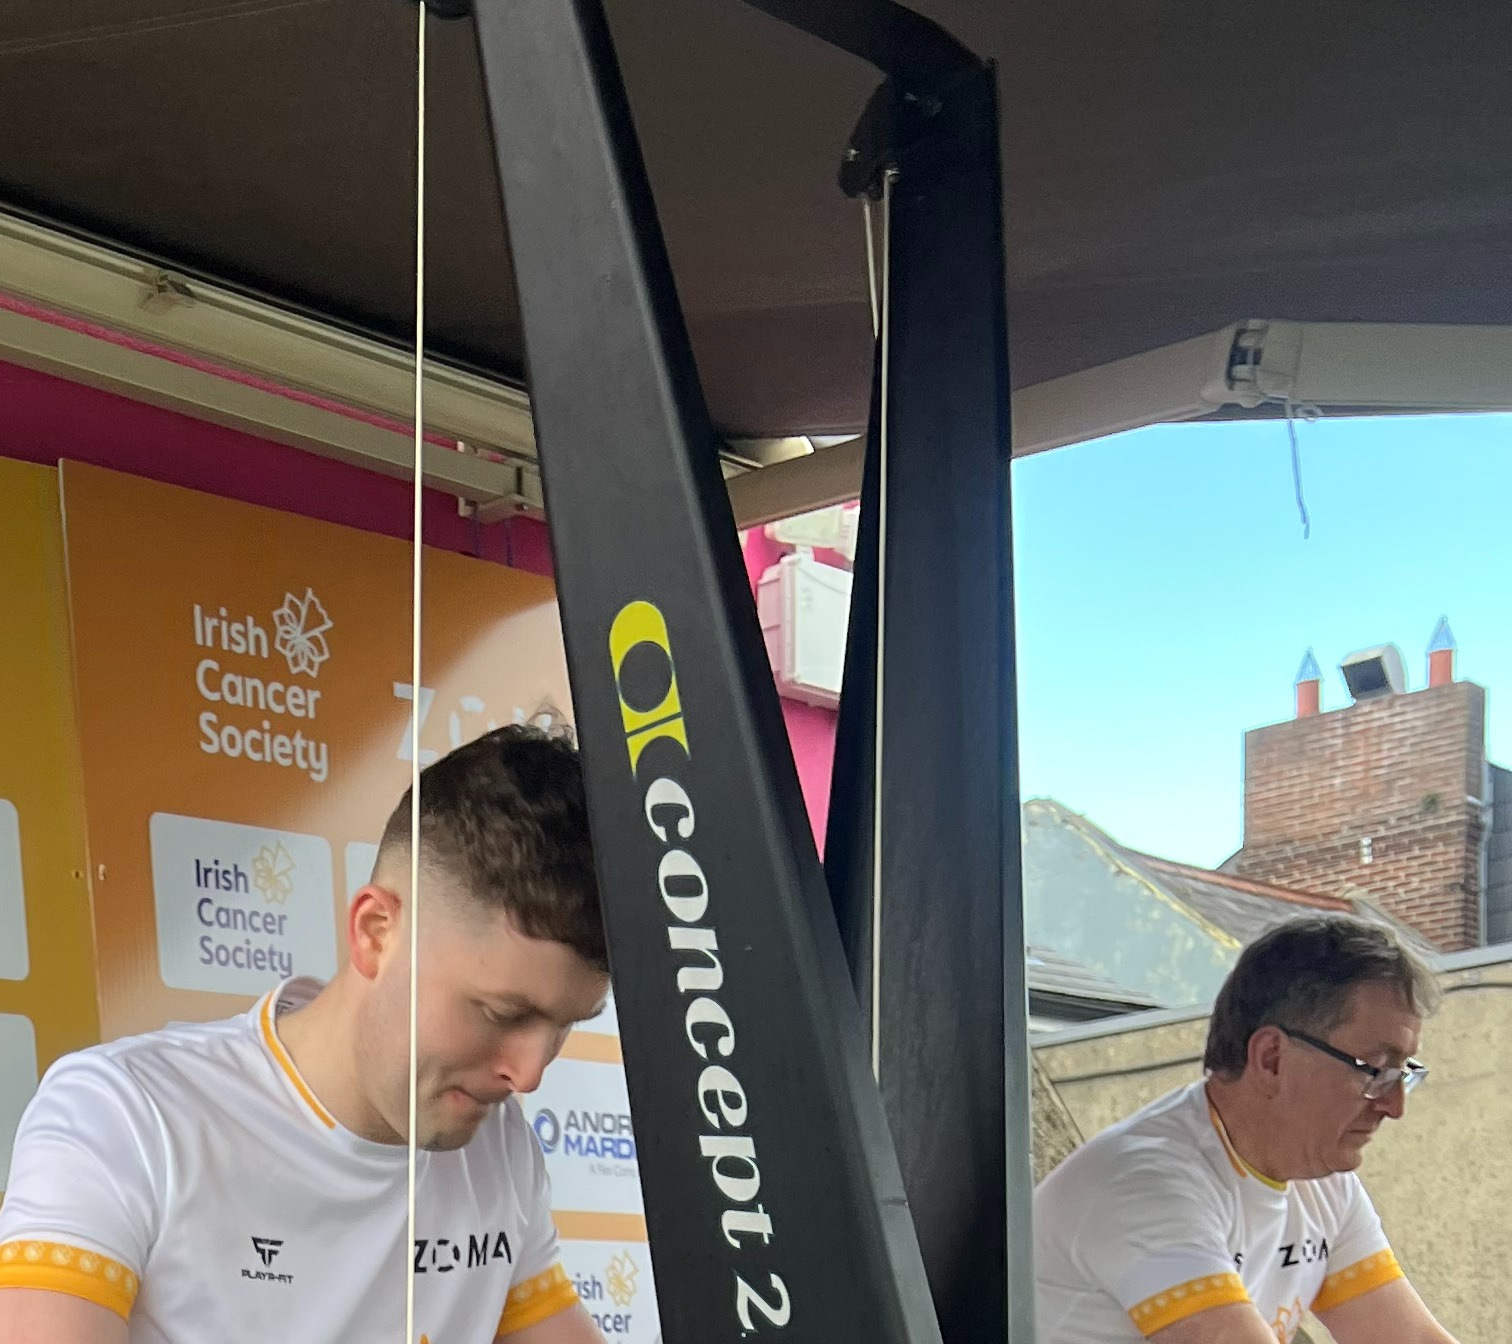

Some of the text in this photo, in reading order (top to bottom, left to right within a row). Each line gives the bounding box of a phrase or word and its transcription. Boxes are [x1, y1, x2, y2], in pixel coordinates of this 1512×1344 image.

[193, 604, 268, 658] Irish
[196, 659, 321, 719] Cancer
[199, 712, 328, 782] Society
[195, 858, 249, 894] Irish
[197, 899, 287, 936] Cancer
[199, 936, 293, 979] Society
[644, 776, 791, 1337] concept 2
[564, 1110, 632, 1135] ANOR
[564, 1134, 636, 1160] MARD
